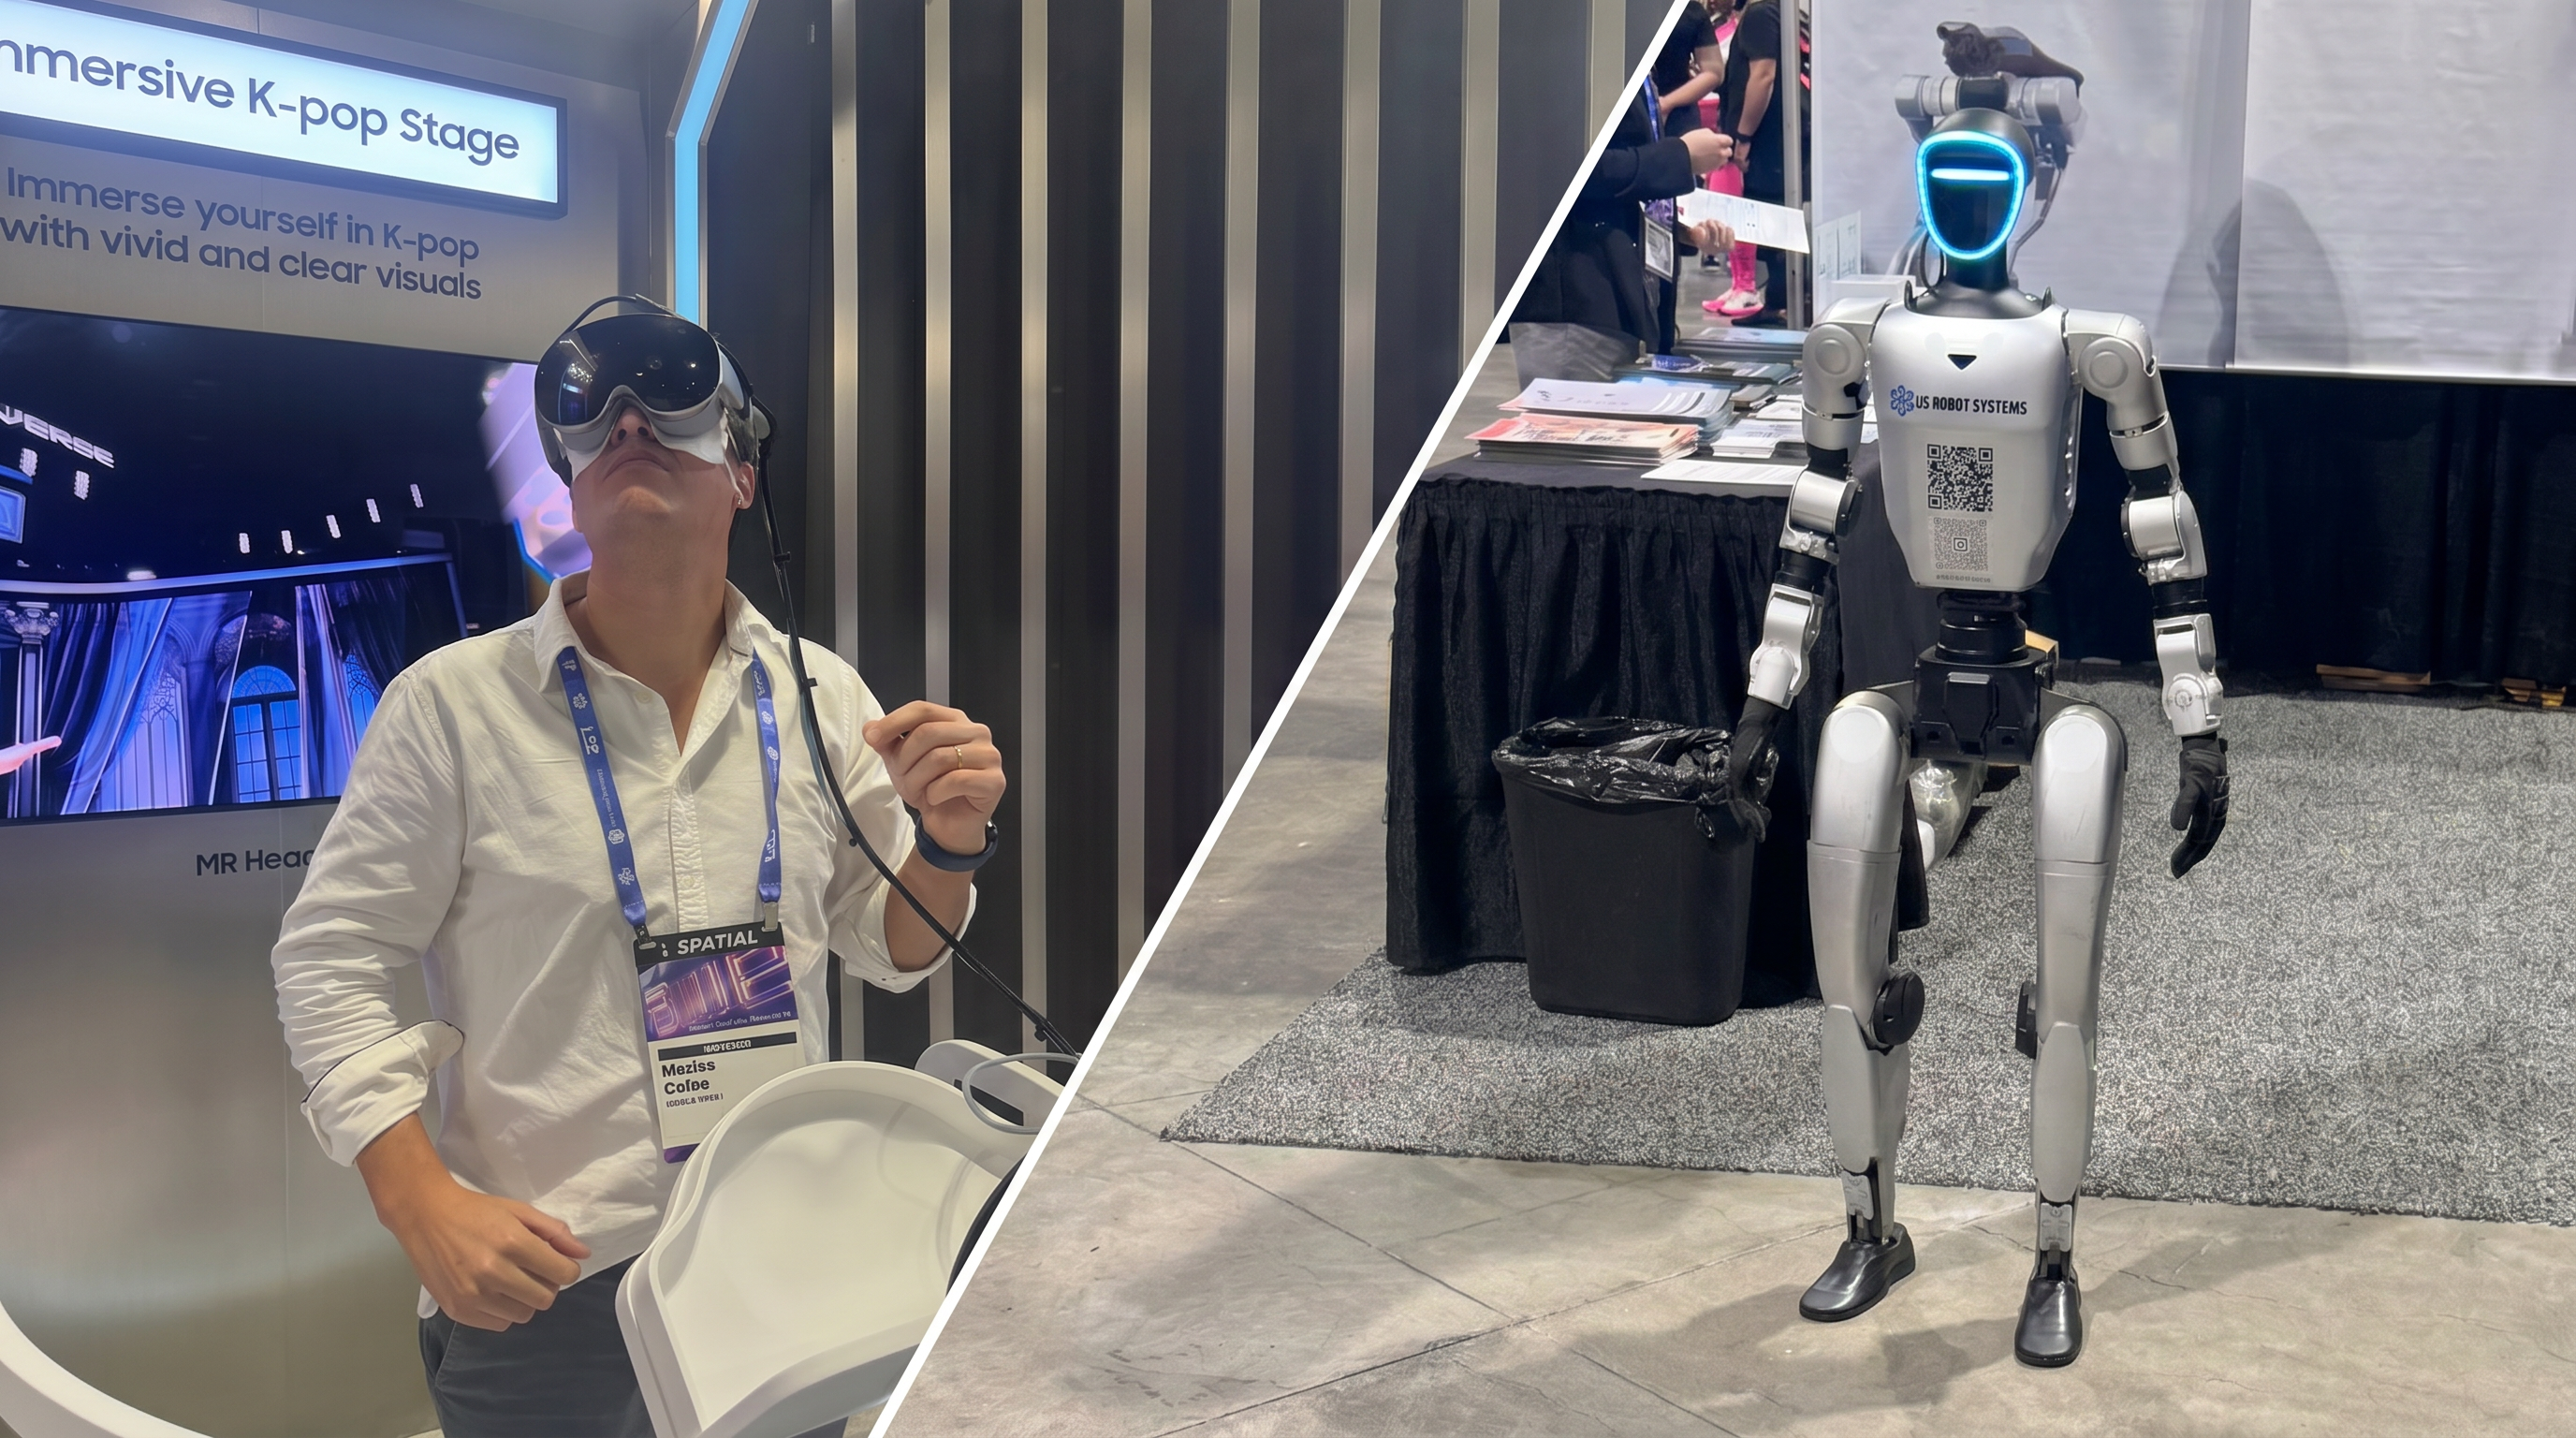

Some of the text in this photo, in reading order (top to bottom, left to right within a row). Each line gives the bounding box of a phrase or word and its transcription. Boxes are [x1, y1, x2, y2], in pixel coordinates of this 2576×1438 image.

[248, 78, 388, 146] K-pop
[400, 108, 520, 166] Stage
[7, 167, 479, 268] Immerse yourself in K-pop
[0, 213, 482, 300] with vivid and clear visuals
[1916, 395, 2027, 415] US ROBOT SYSTEMS
[197, 852, 238, 876] MR
[677, 930, 758, 955] SPATIAL
